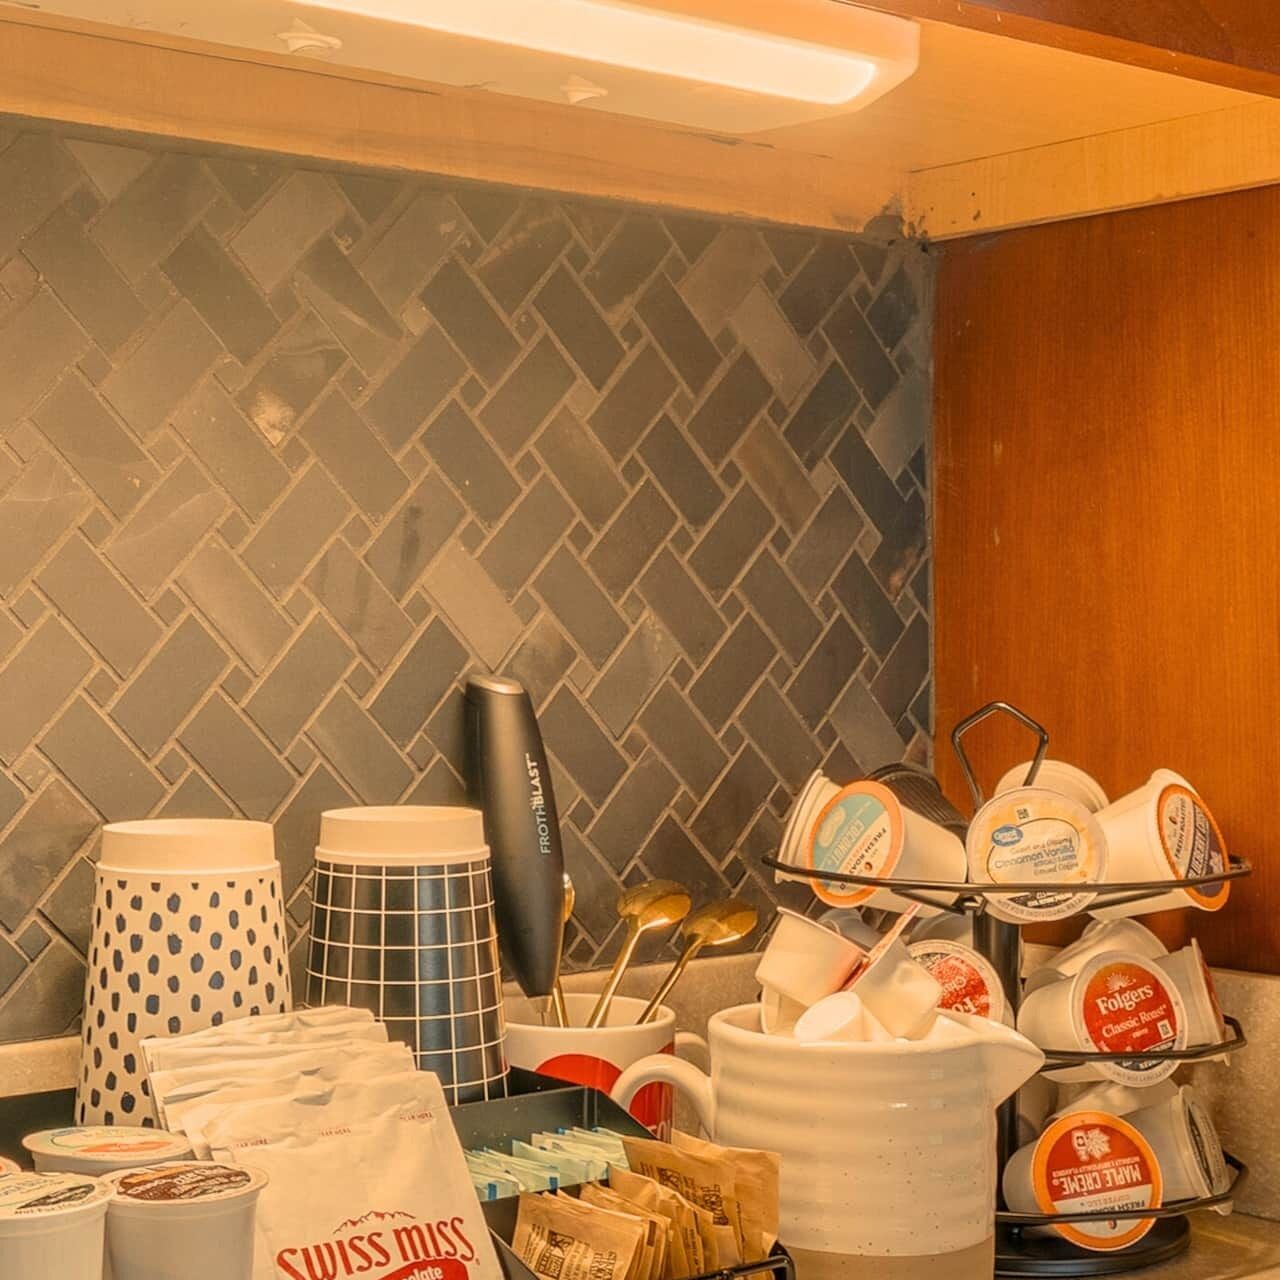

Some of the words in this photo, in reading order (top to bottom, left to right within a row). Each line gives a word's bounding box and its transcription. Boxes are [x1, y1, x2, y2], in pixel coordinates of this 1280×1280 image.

[1096, 984, 1154, 1016] Folgers
[1102, 1016, 1140, 1038] Classic
[1060, 1171, 1101, 1196] CRÈME
[1103, 1164, 1142, 1187] MAPLE
[392, 1216, 475, 1263] MISS
